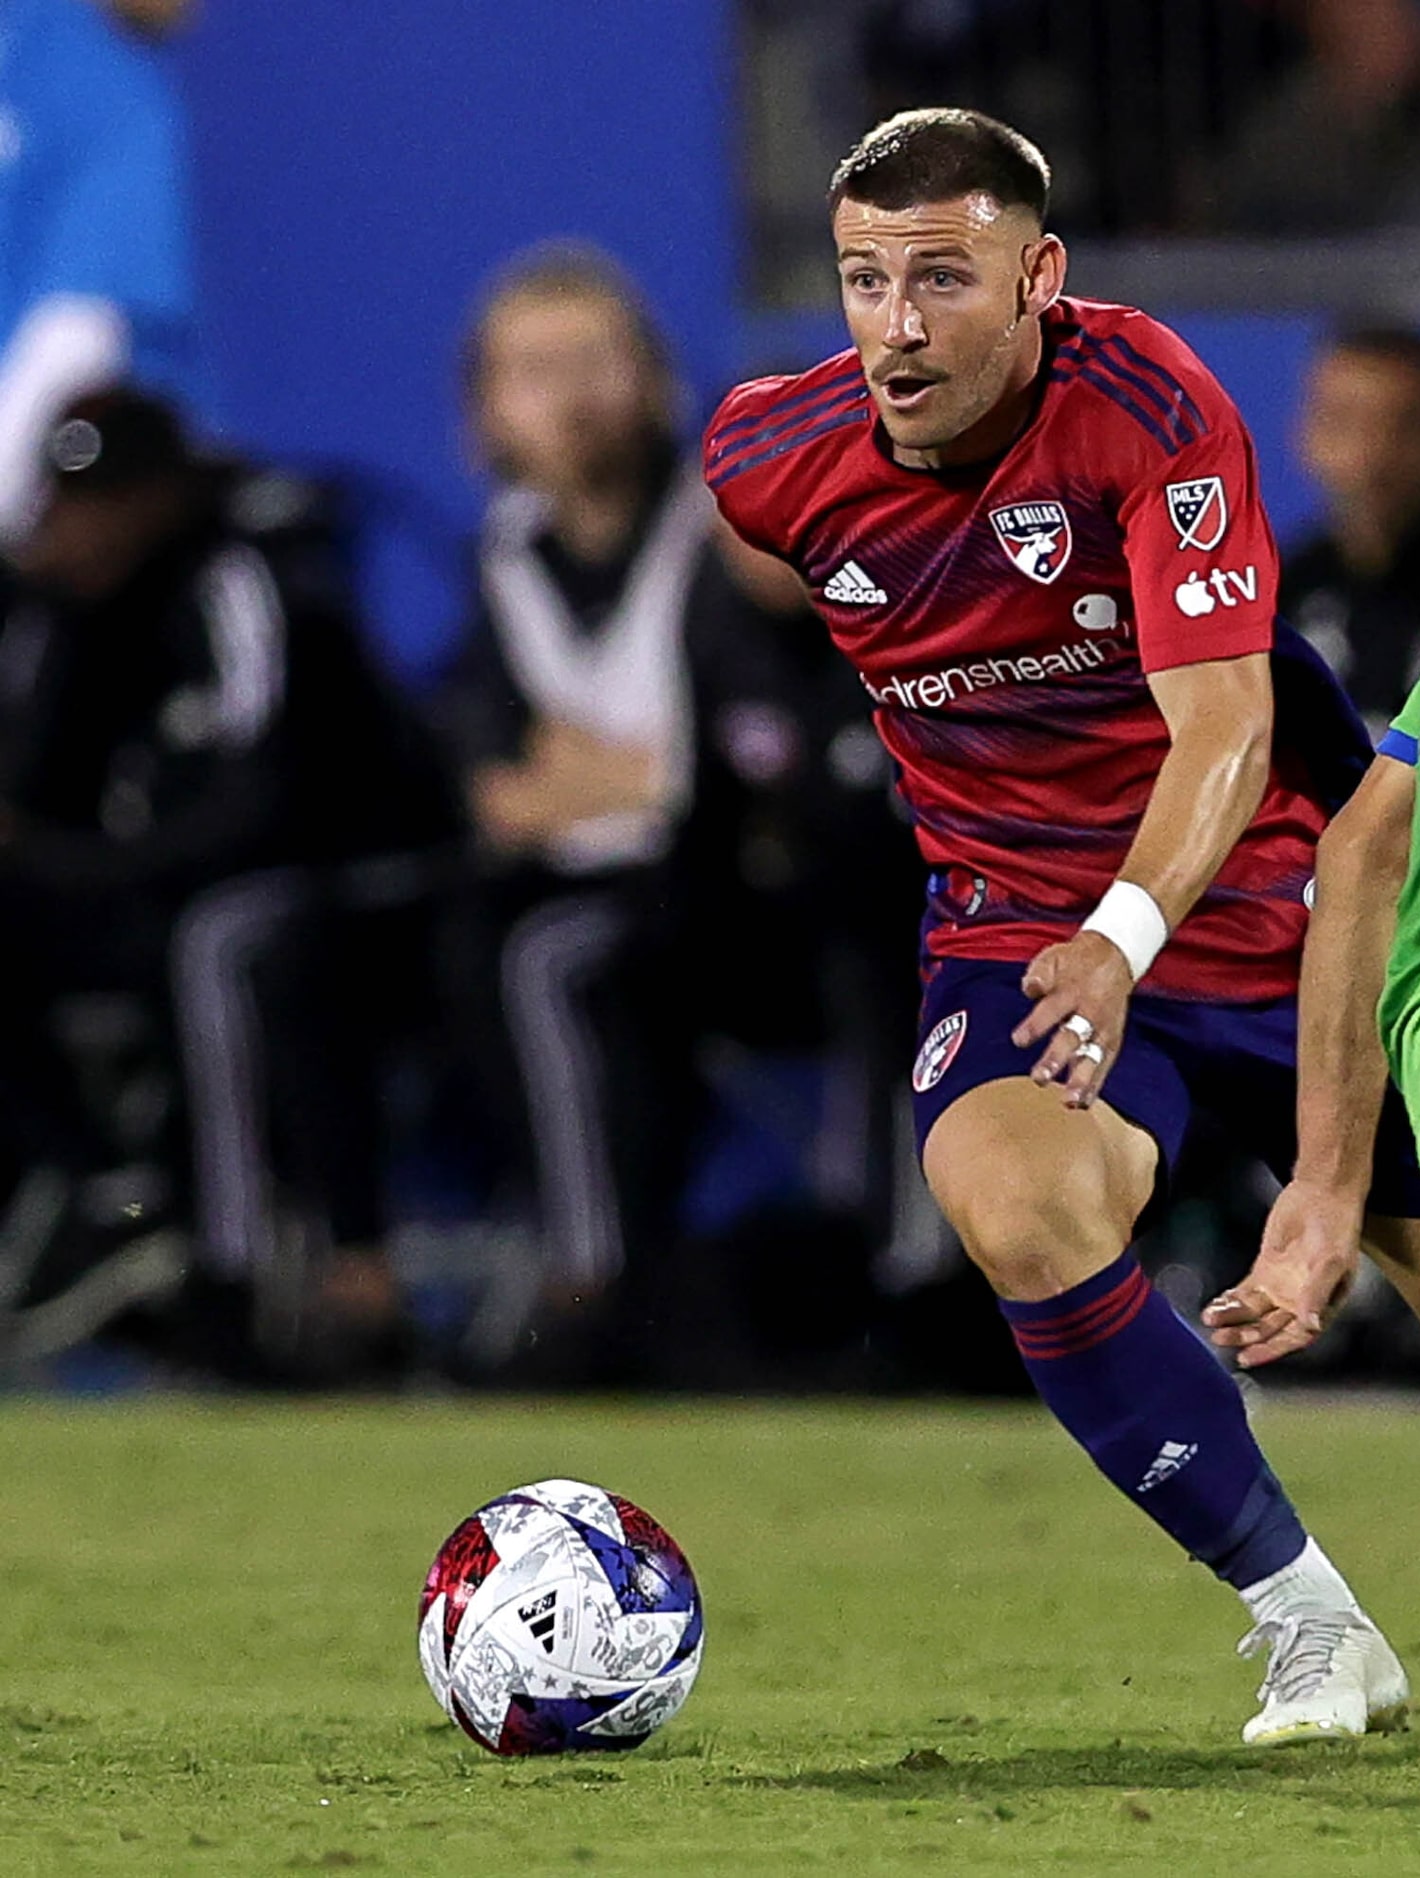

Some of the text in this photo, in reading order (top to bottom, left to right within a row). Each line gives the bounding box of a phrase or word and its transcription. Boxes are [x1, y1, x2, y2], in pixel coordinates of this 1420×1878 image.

[1173, 485, 1205, 504] MLS
[1013, 505, 1061, 527] DALLAS
[824, 585, 888, 605] adidas
[1209, 565, 1258, 608] tv
